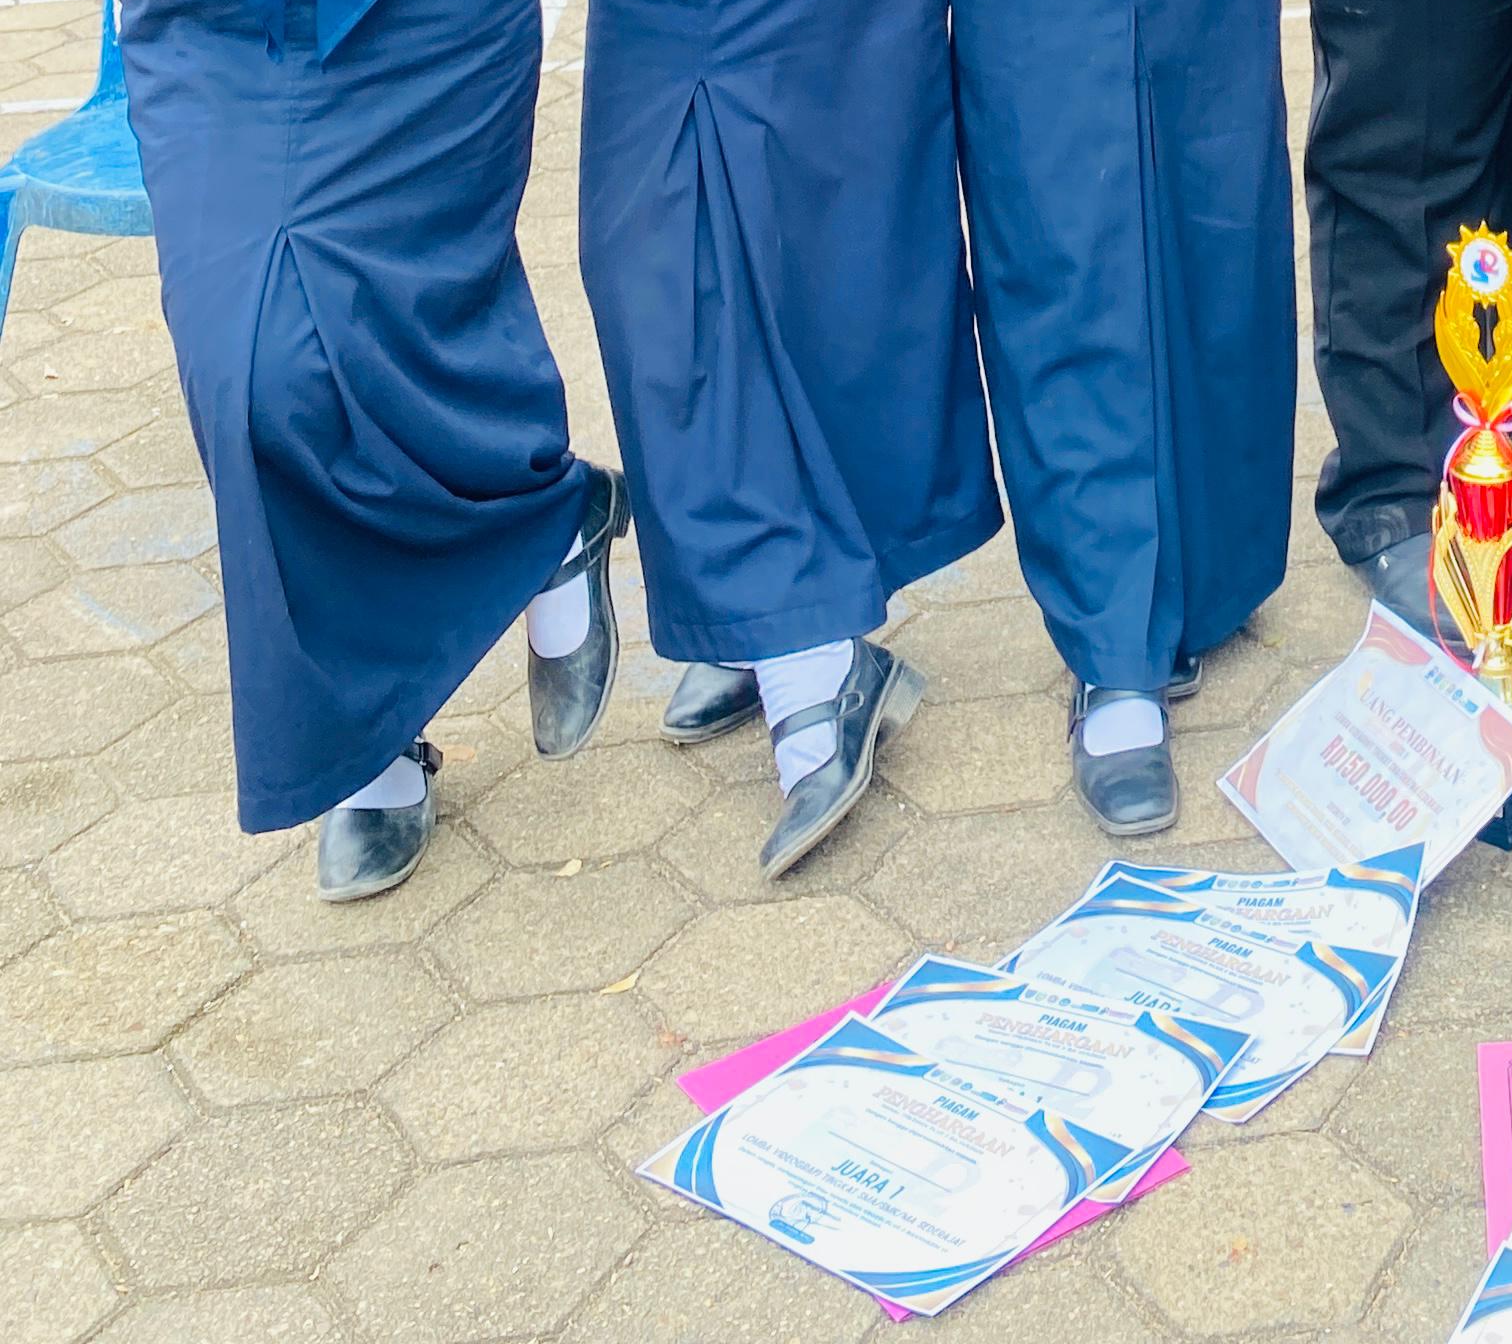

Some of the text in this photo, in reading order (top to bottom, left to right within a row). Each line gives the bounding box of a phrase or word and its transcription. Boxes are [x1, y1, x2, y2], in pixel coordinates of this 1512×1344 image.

[1360, 687, 1396, 723] UANG
[1391, 716, 1460, 785] PEMBINAAN
[1320, 733, 1418, 832] Rp150.000,00
[1237, 896, 1285, 908] PIAGAM
[1150, 929, 1291, 987] PENGHARGAAN
[1207, 937, 1253, 959] PIAGAM
[1123, 991, 1182, 1013] JUAR
[975, 1012, 1136, 1060] PENGHARGAAN
[1038, 1013, 1088, 1033] PIAGAM
[872, 1085, 1016, 1158] PENGHARGAAN
[932, 1095, 981, 1121] PIAGAM
[830, 1159, 905, 1200] JUARA 1
